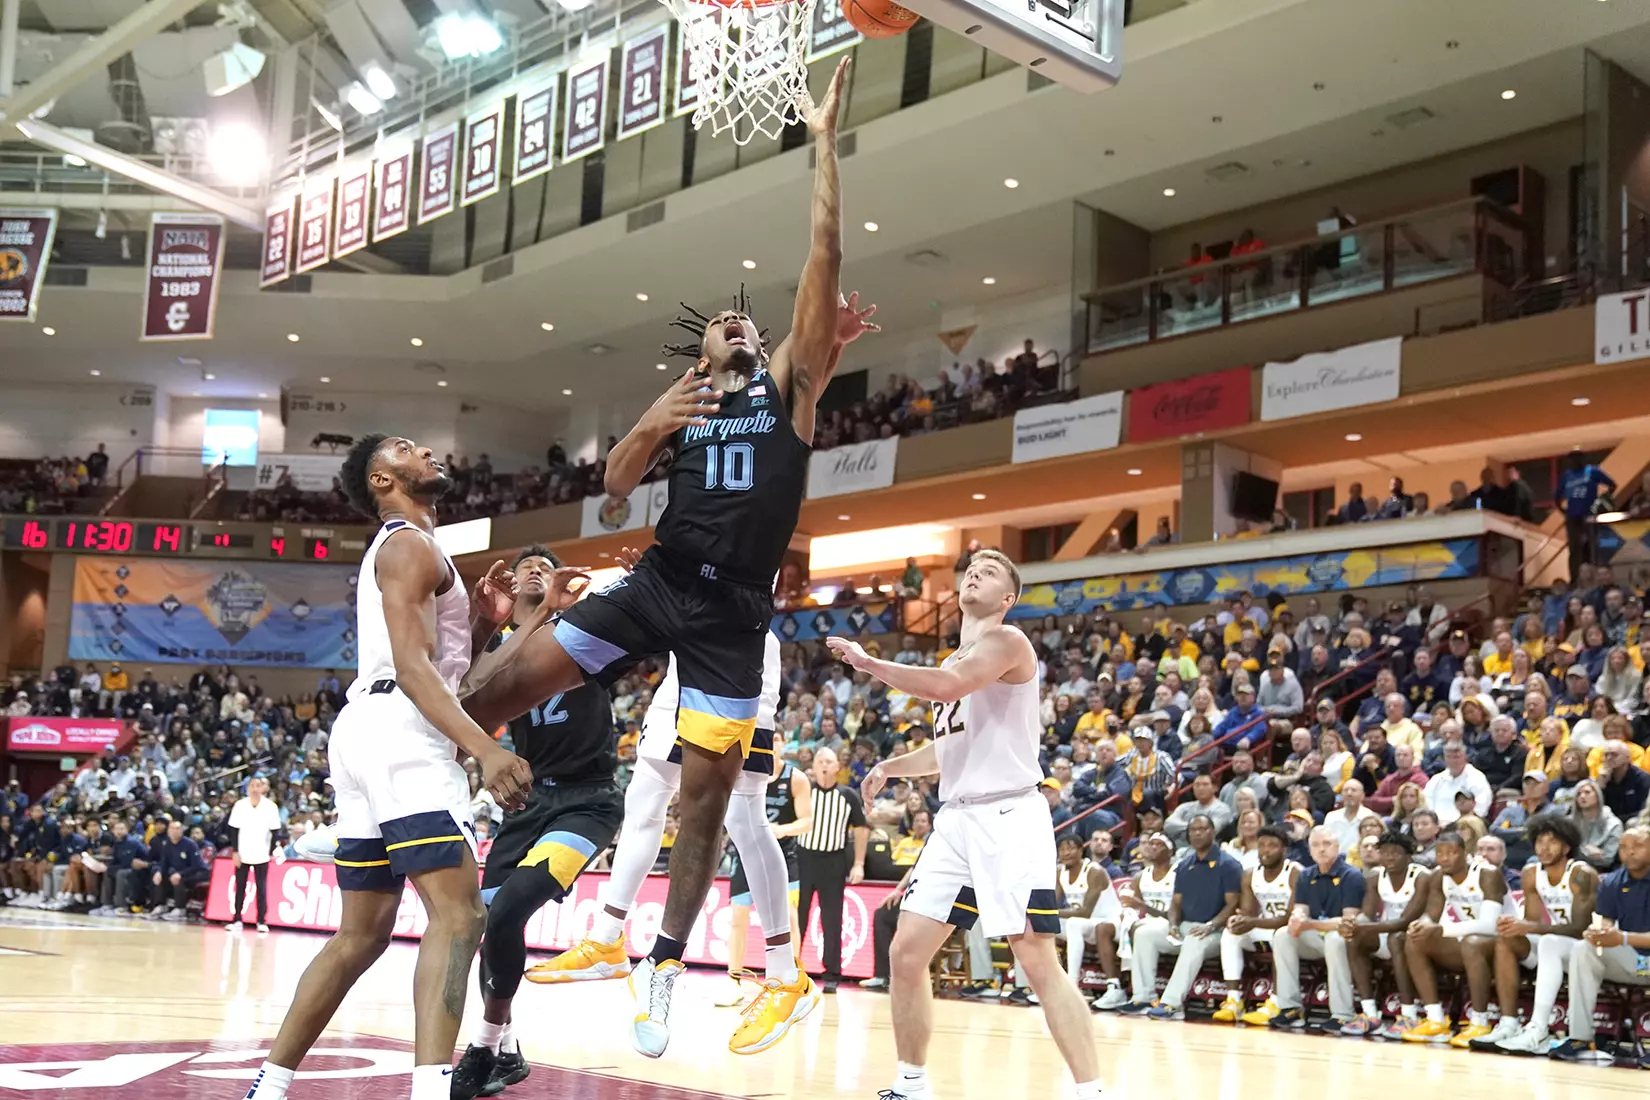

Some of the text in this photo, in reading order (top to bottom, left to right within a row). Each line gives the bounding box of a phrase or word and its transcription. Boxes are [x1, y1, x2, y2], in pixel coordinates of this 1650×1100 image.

[631, 72, 653, 105] 21
[574, 97, 596, 129] 42
[472, 144, 492, 175] 10
[428, 165, 447, 193] 55
[1266, 380, 1319, 400] Explore
[684, 409, 777, 443] Marquette
[1016, 432, 1037, 446] BUD
[704, 441, 755, 492] 10
[21, 521, 47, 549] 16
[66, 521, 133, 551] 11:30
[153, 526, 181, 551] 14
[271, 537, 284, 556] 4
[313, 540, 327, 559] 6
[932, 699, 965, 738] 22
